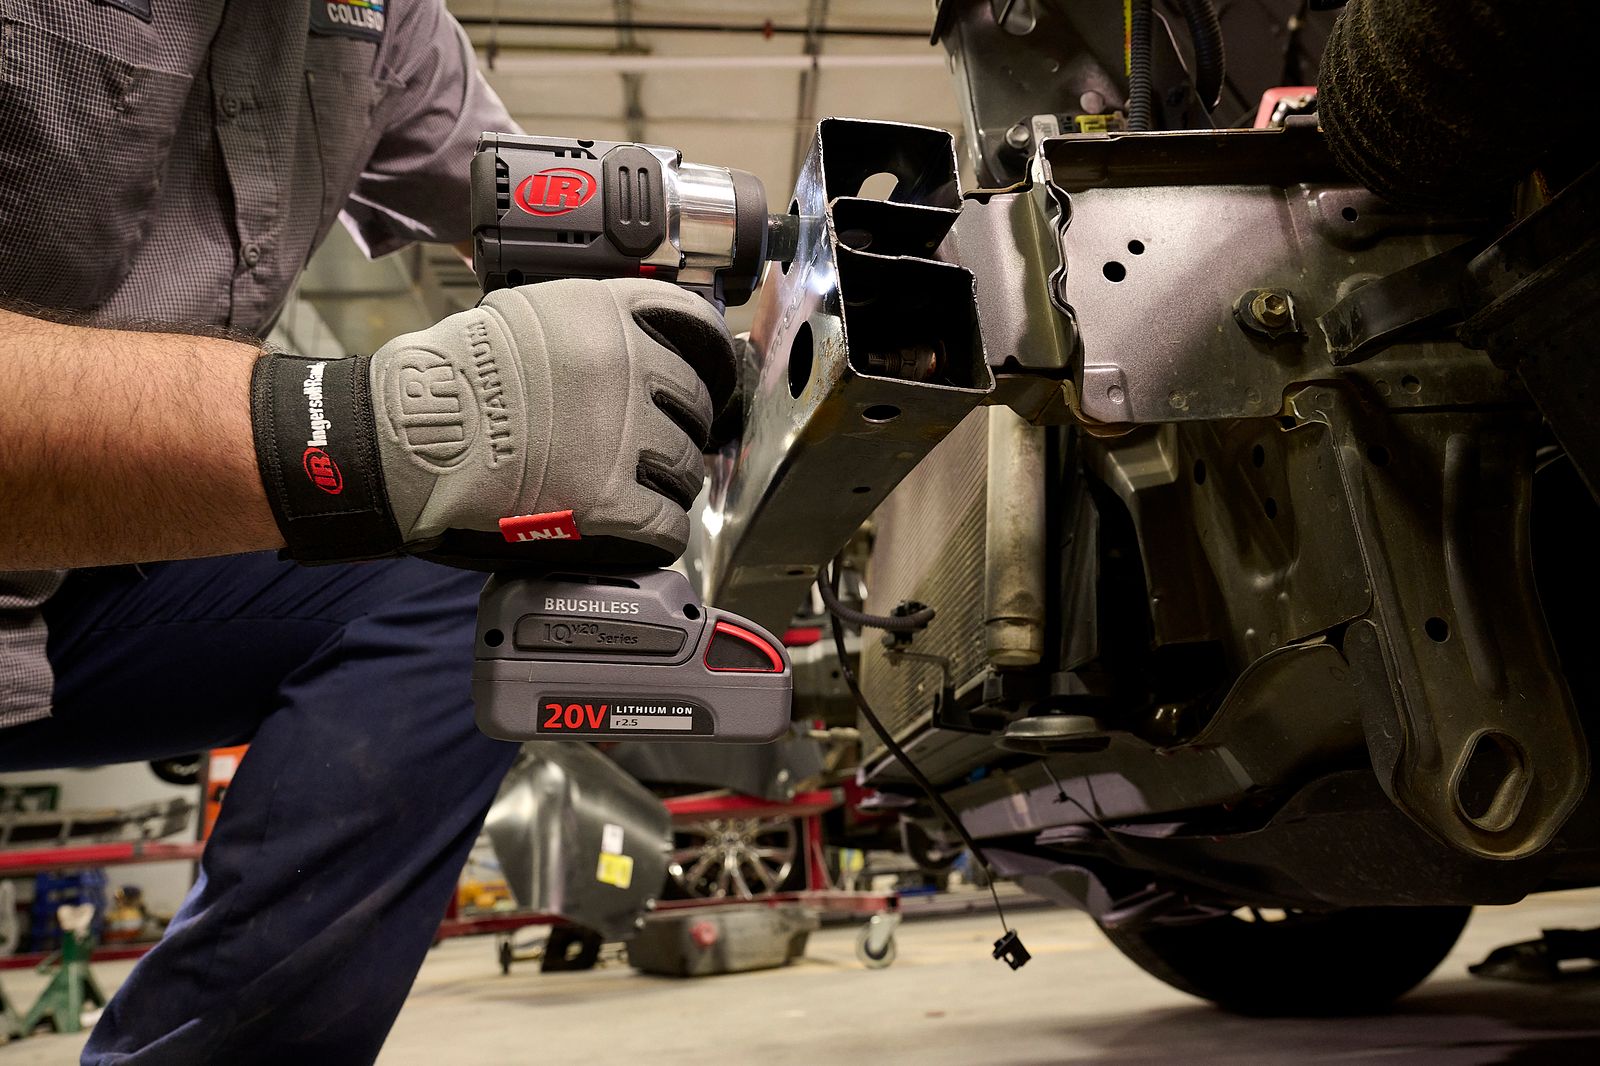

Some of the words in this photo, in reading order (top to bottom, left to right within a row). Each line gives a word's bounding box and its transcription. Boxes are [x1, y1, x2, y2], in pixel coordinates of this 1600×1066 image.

[527, 174, 583, 208] IR
[467, 321, 515, 465] TITANIUM
[399, 361, 465, 447] IR
[516, 527, 571, 542] TNT
[544, 598, 640, 614] BRUSHLESS
[597, 633, 639, 645] Series
[543, 703, 608, 729] 20V
[616, 705, 667, 715] LITHIUM
[672, 706, 693, 715] ION
